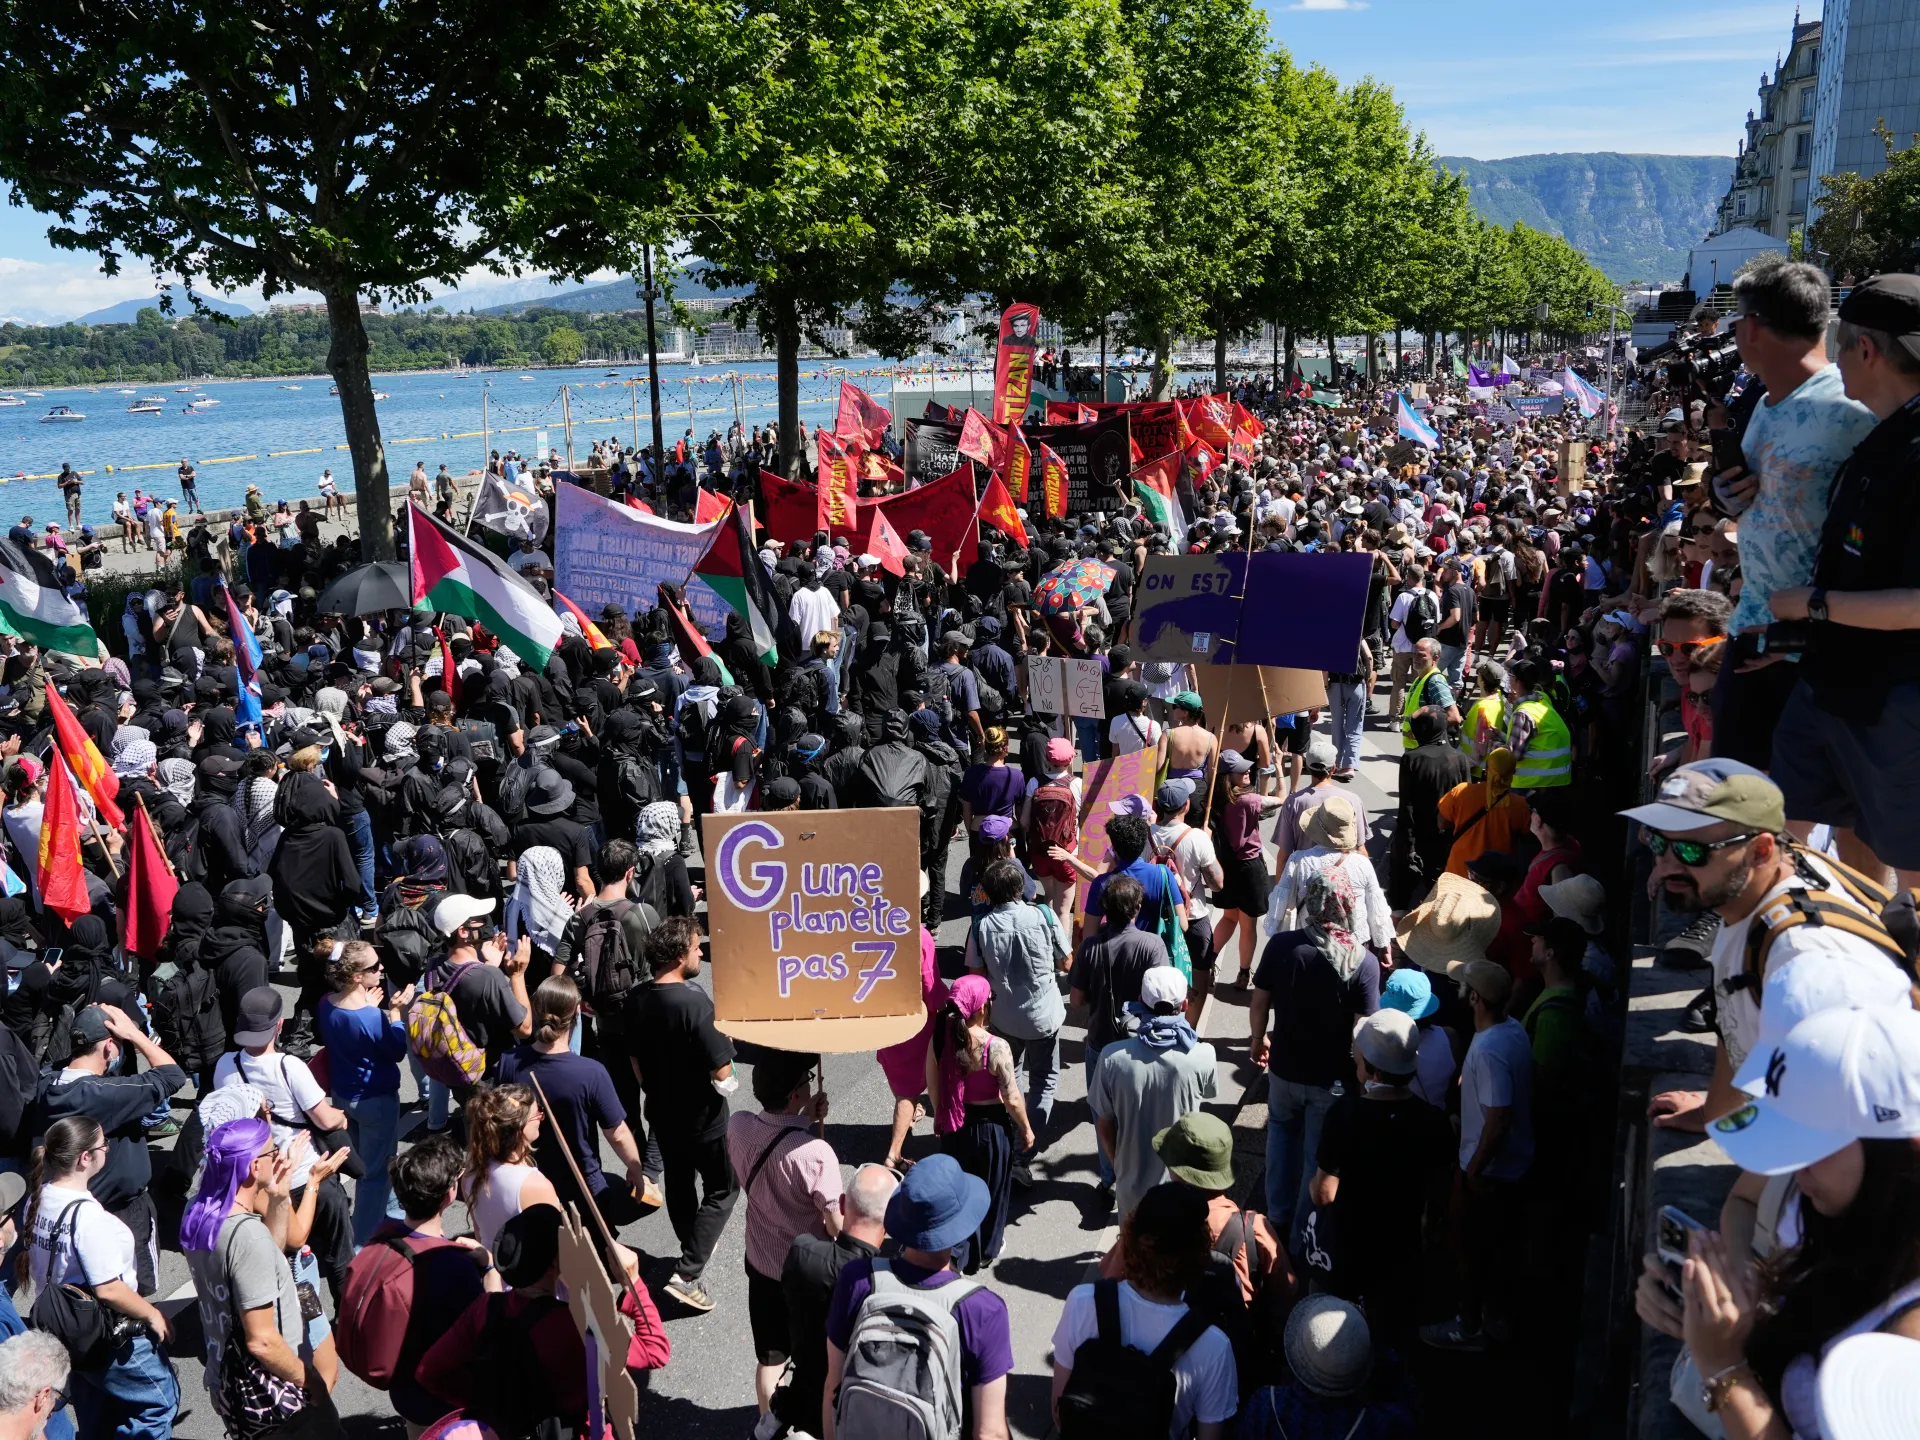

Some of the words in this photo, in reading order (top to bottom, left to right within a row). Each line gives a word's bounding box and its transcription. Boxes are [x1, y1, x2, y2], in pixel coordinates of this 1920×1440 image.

[1145, 573, 1175, 590] ON
[1190, 573, 1229, 593] EST
[1033, 671, 1054, 697] NO
[1076, 661, 1089, 672] NO
[715, 820, 788, 912] G
[801, 862, 883, 897] une
[769, 892, 912, 952] planète
[777, 952, 849, 998] pas
[851, 941, 897, 1003] 7
